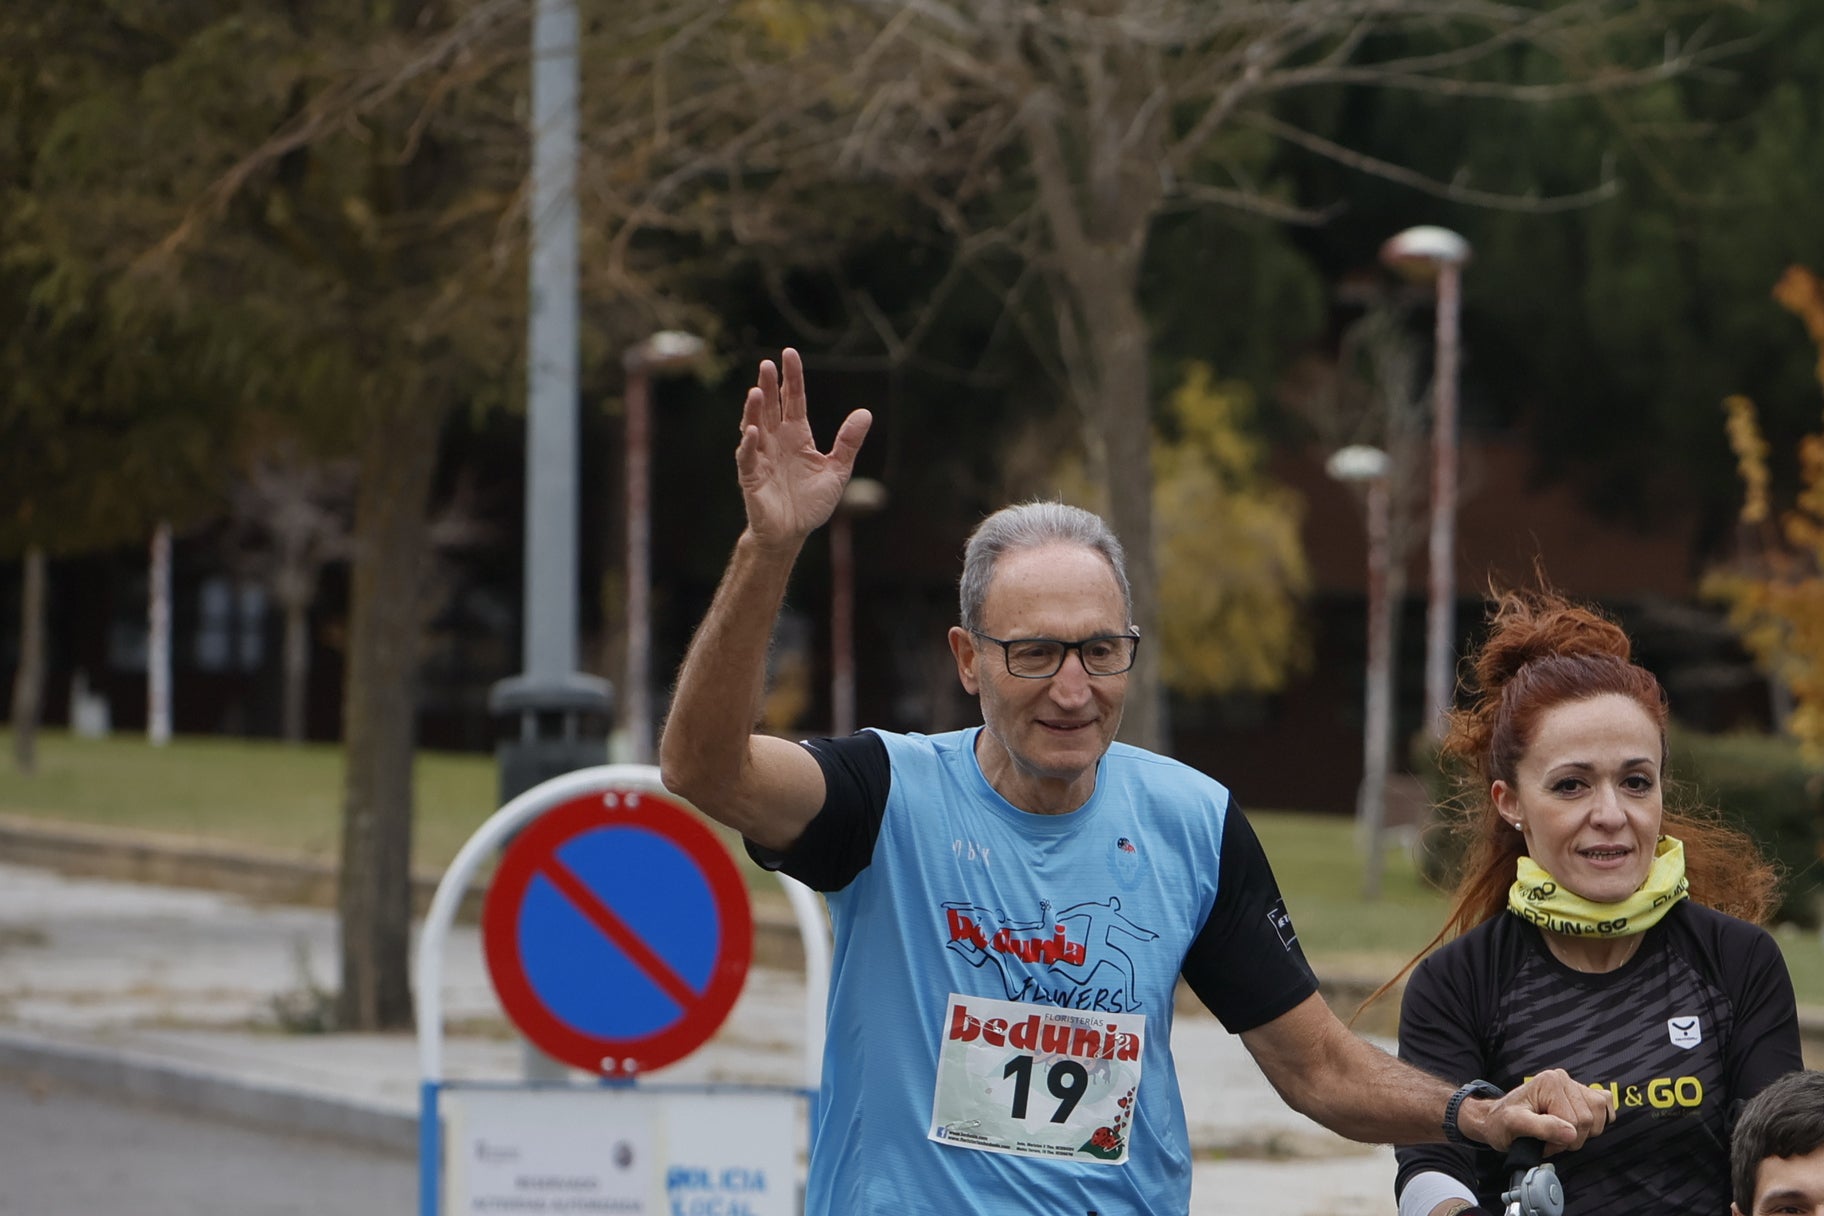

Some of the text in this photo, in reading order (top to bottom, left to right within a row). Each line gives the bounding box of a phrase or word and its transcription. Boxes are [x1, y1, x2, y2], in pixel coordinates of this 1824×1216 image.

[1599, 917, 1628, 934] GO
[949, 1005, 1141, 1063] bedunia
[1043, 1012, 1105, 1028] FLORISTERÍAS
[1003, 1054, 1089, 1124] 19
[1624, 1085, 1644, 1107] &
[1647, 1076, 1703, 1110] GO
